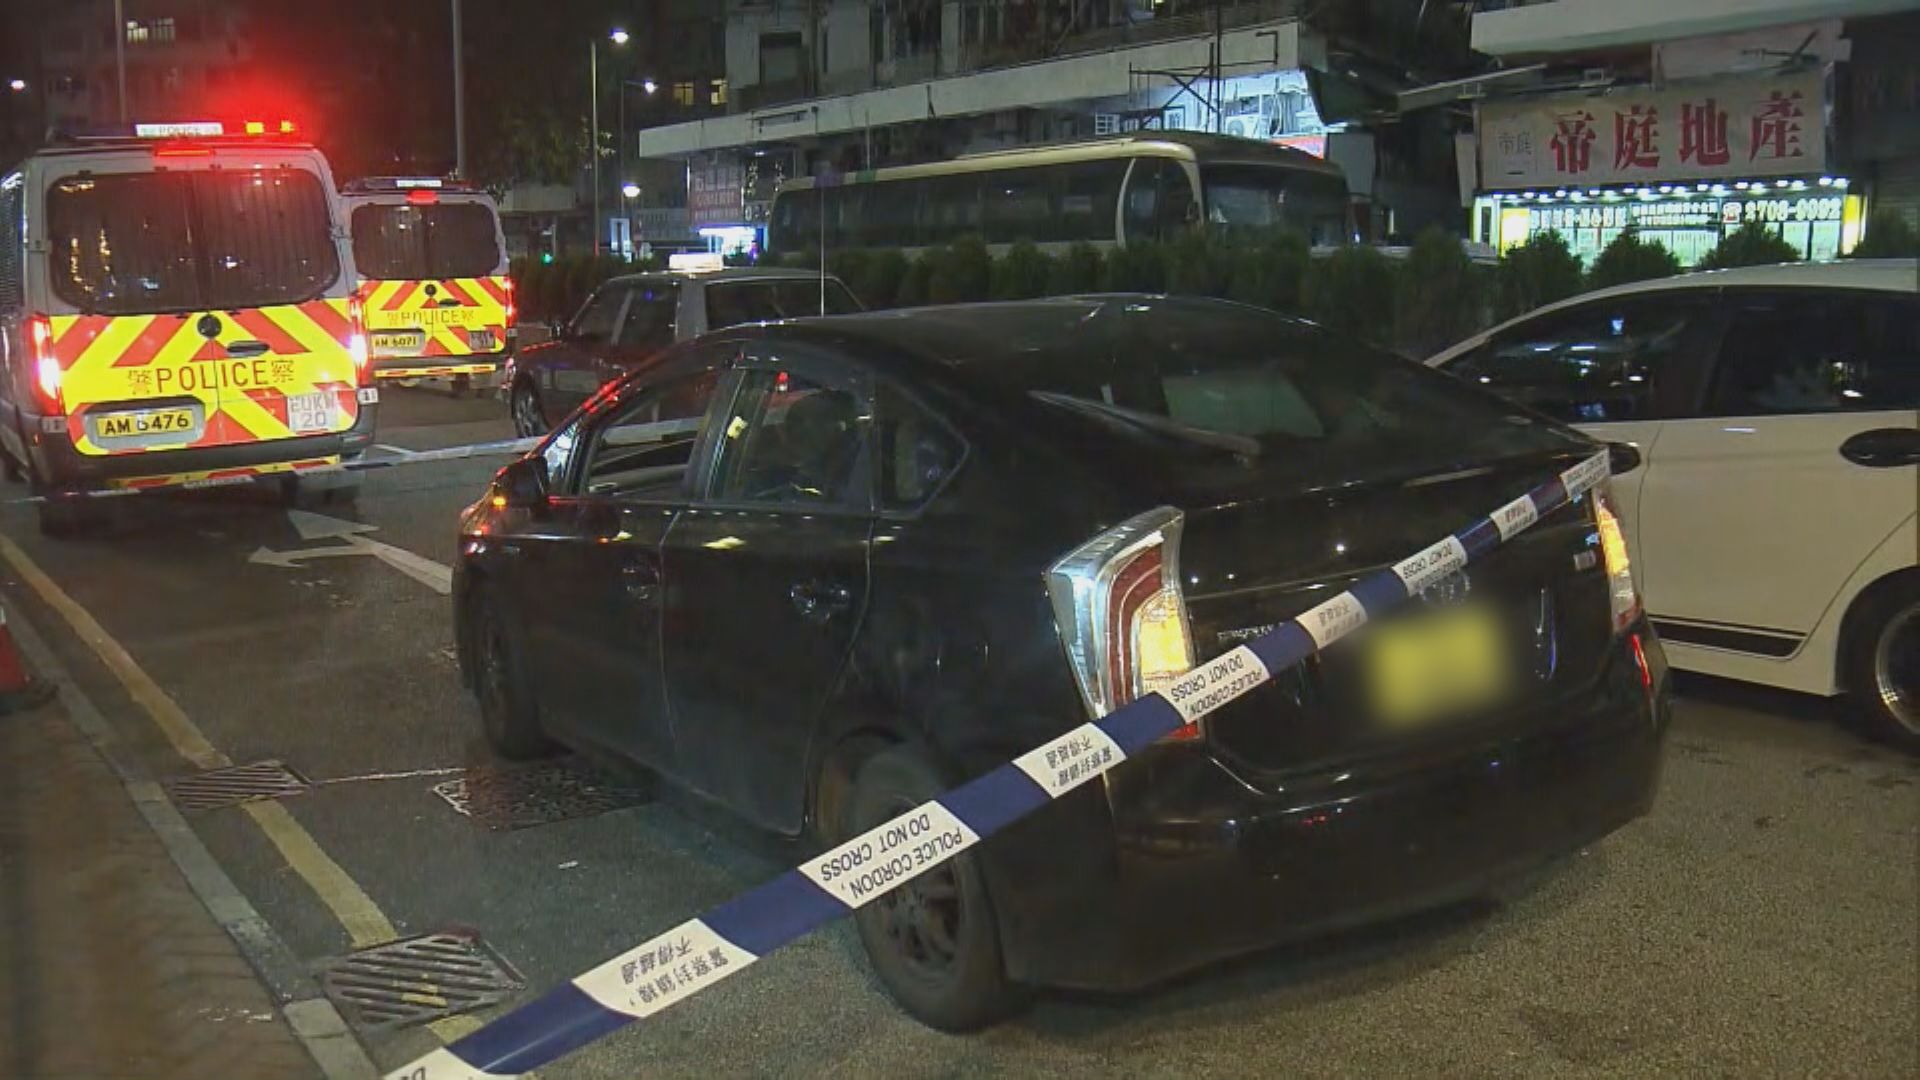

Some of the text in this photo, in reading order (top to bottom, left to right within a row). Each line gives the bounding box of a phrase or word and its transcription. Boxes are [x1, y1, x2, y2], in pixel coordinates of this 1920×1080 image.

[1549, 91, 1804, 174] 帝庭地產
[400, 310, 459, 326] POLICE
[156, 360, 268, 393] POLICE
[104, 417, 131, 435] AM
[303, 411, 326, 428] 20
[1171, 653, 1244, 702] DO NOT CROSS
[1231, 666, 1263, 696] POLICE
[821, 813, 930, 881] DO NOT CROSS
[912, 826, 963, 866] POLICE
[621, 935, 693, 985] 不得越過
